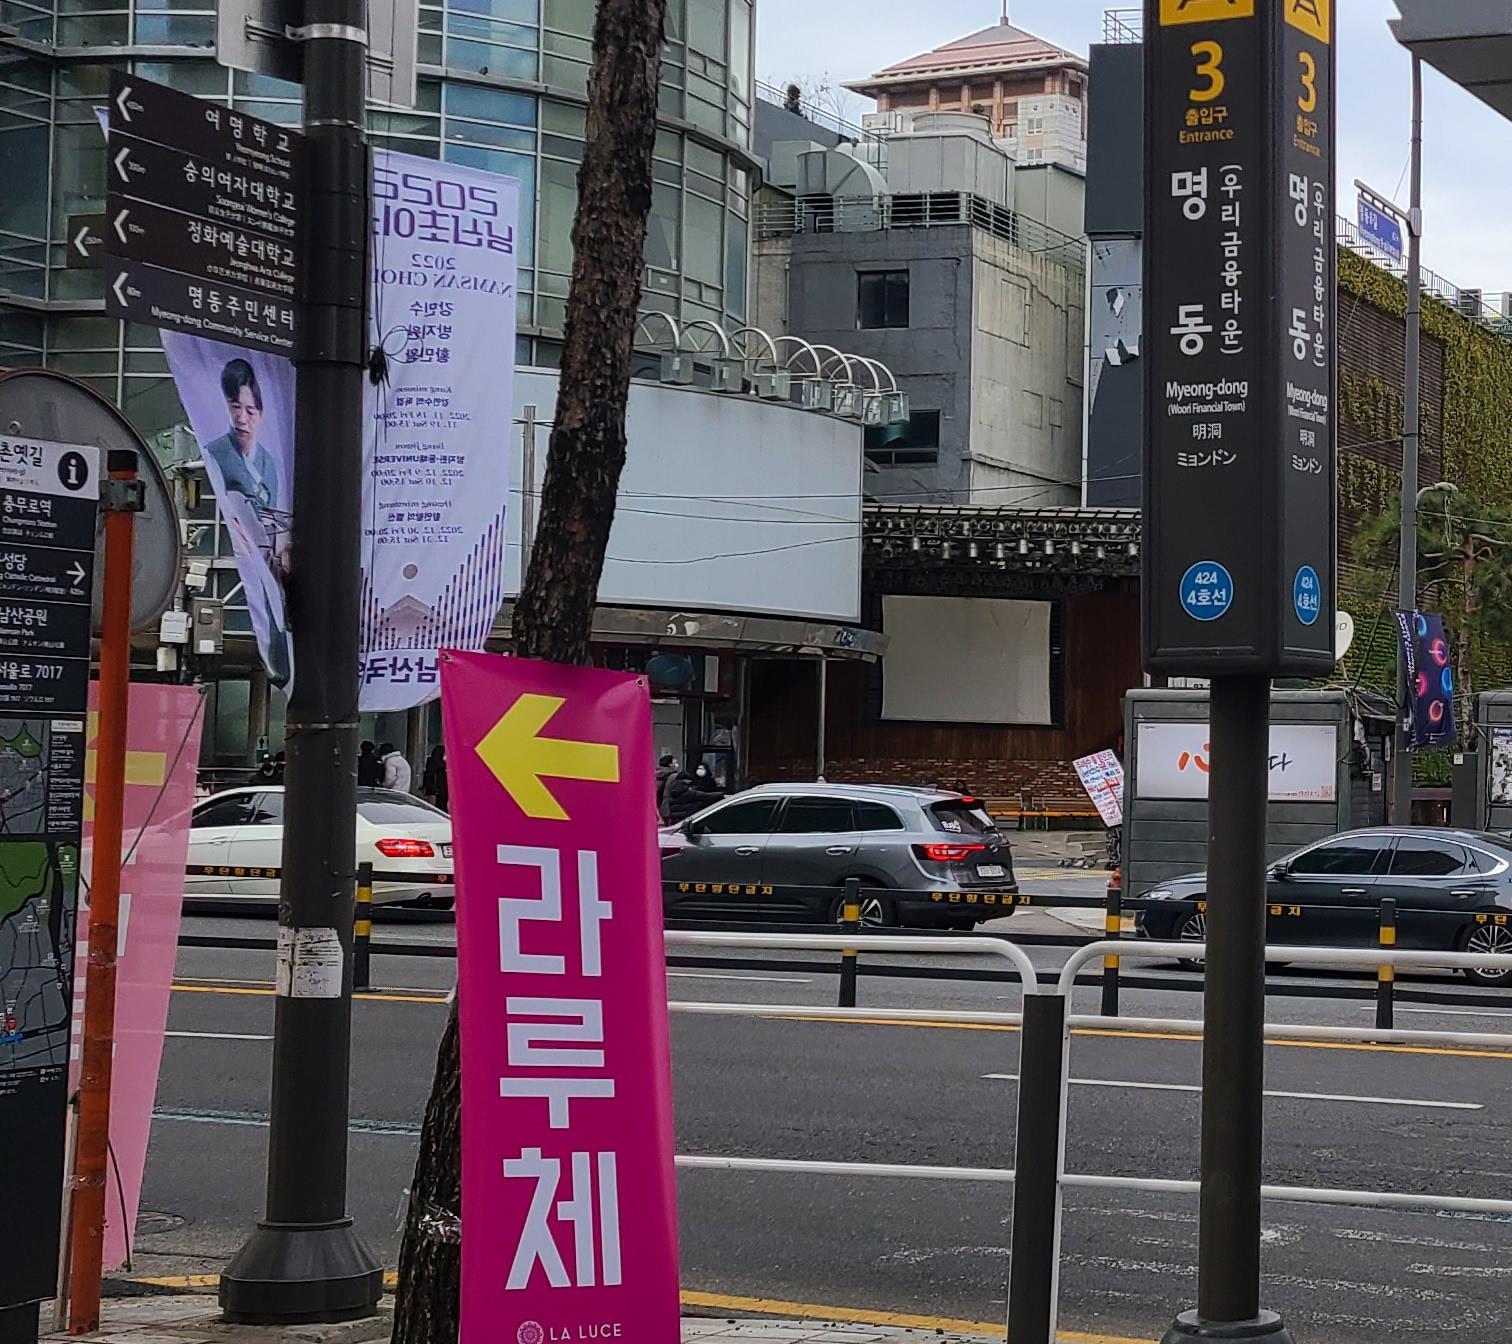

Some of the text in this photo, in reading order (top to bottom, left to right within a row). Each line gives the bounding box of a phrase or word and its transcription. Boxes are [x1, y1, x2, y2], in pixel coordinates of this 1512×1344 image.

[1188, 40, 1226, 102] 3
[1297, 51, 1317, 114] 3
[1184, 106, 1229, 127] 출입구
[1178, 127, 1235, 145] Entrance
[183, 159, 297, 211] 숭의여자대학교
[187, 219, 296, 268] 정화예술대학교
[187, 284, 295, 332] 명동주민센터
[269, 334, 295, 349] Center
[1166, 377, 1249, 402] Myeong-dong
[1286, 380, 1328, 413] Myeong-dong
[1192, 401, 1223, 414] Financial
[1224, 399, 1246, 413] Town)
[1192, 422, 1222, 440] 明洞
[1299, 428, 1315, 448] 明洞
[1176, 448, 1237, 468] ミョンドン
[2, 494, 52, 518] 충무로역
[1194, 570, 1218, 585] 424
[1186, 588, 1227, 606] 4호선
[35, 664, 64, 680] 7017
[678, 882, 774, 897] 무단횡단금지
[930, 891, 1032, 907] 무단횡단금지
[496, 844, 623, 1289] 라루체
[548, 1323, 622, 1340] LA LUCE
